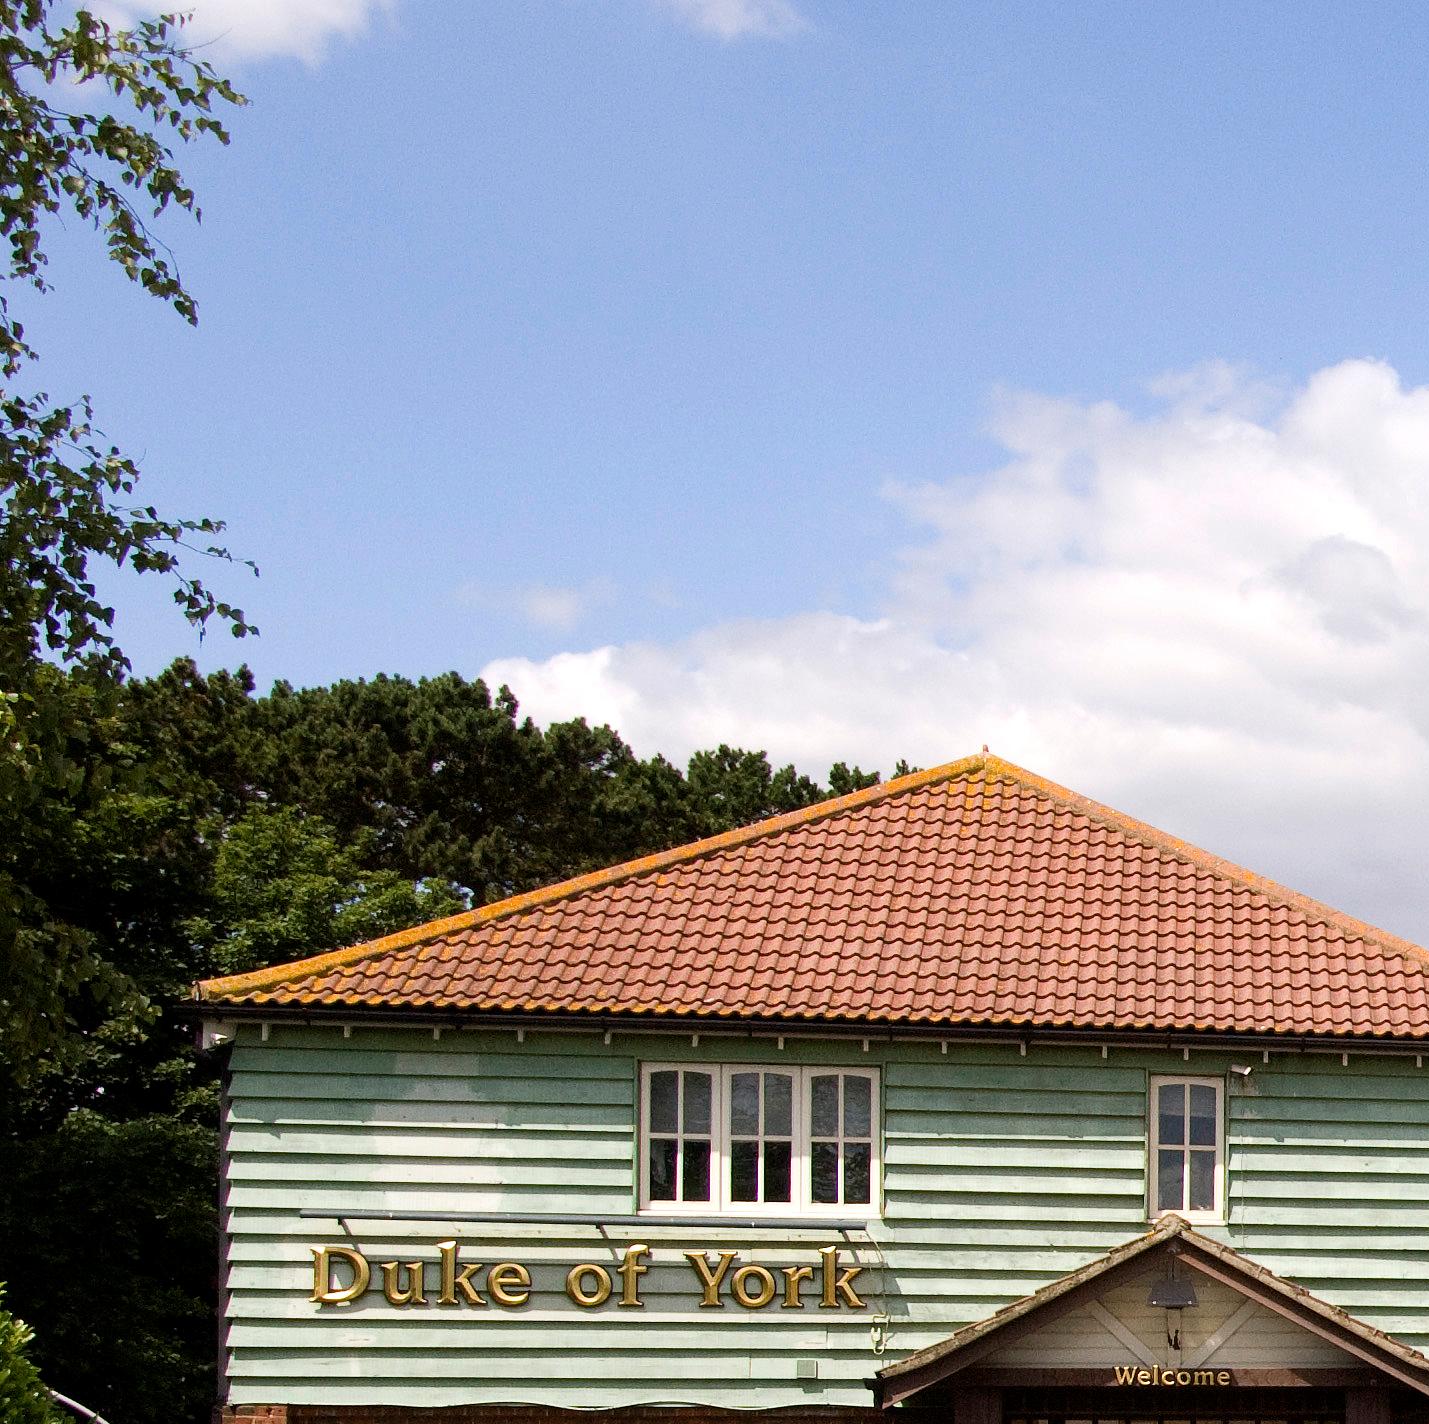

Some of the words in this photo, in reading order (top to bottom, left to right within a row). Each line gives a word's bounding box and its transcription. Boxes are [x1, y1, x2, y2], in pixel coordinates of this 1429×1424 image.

[309, 1240, 533, 1306] Duke
[565, 1244, 650, 1307] of
[682, 1245, 867, 1308] York
[1113, 1364, 1231, 1386] Welcome
